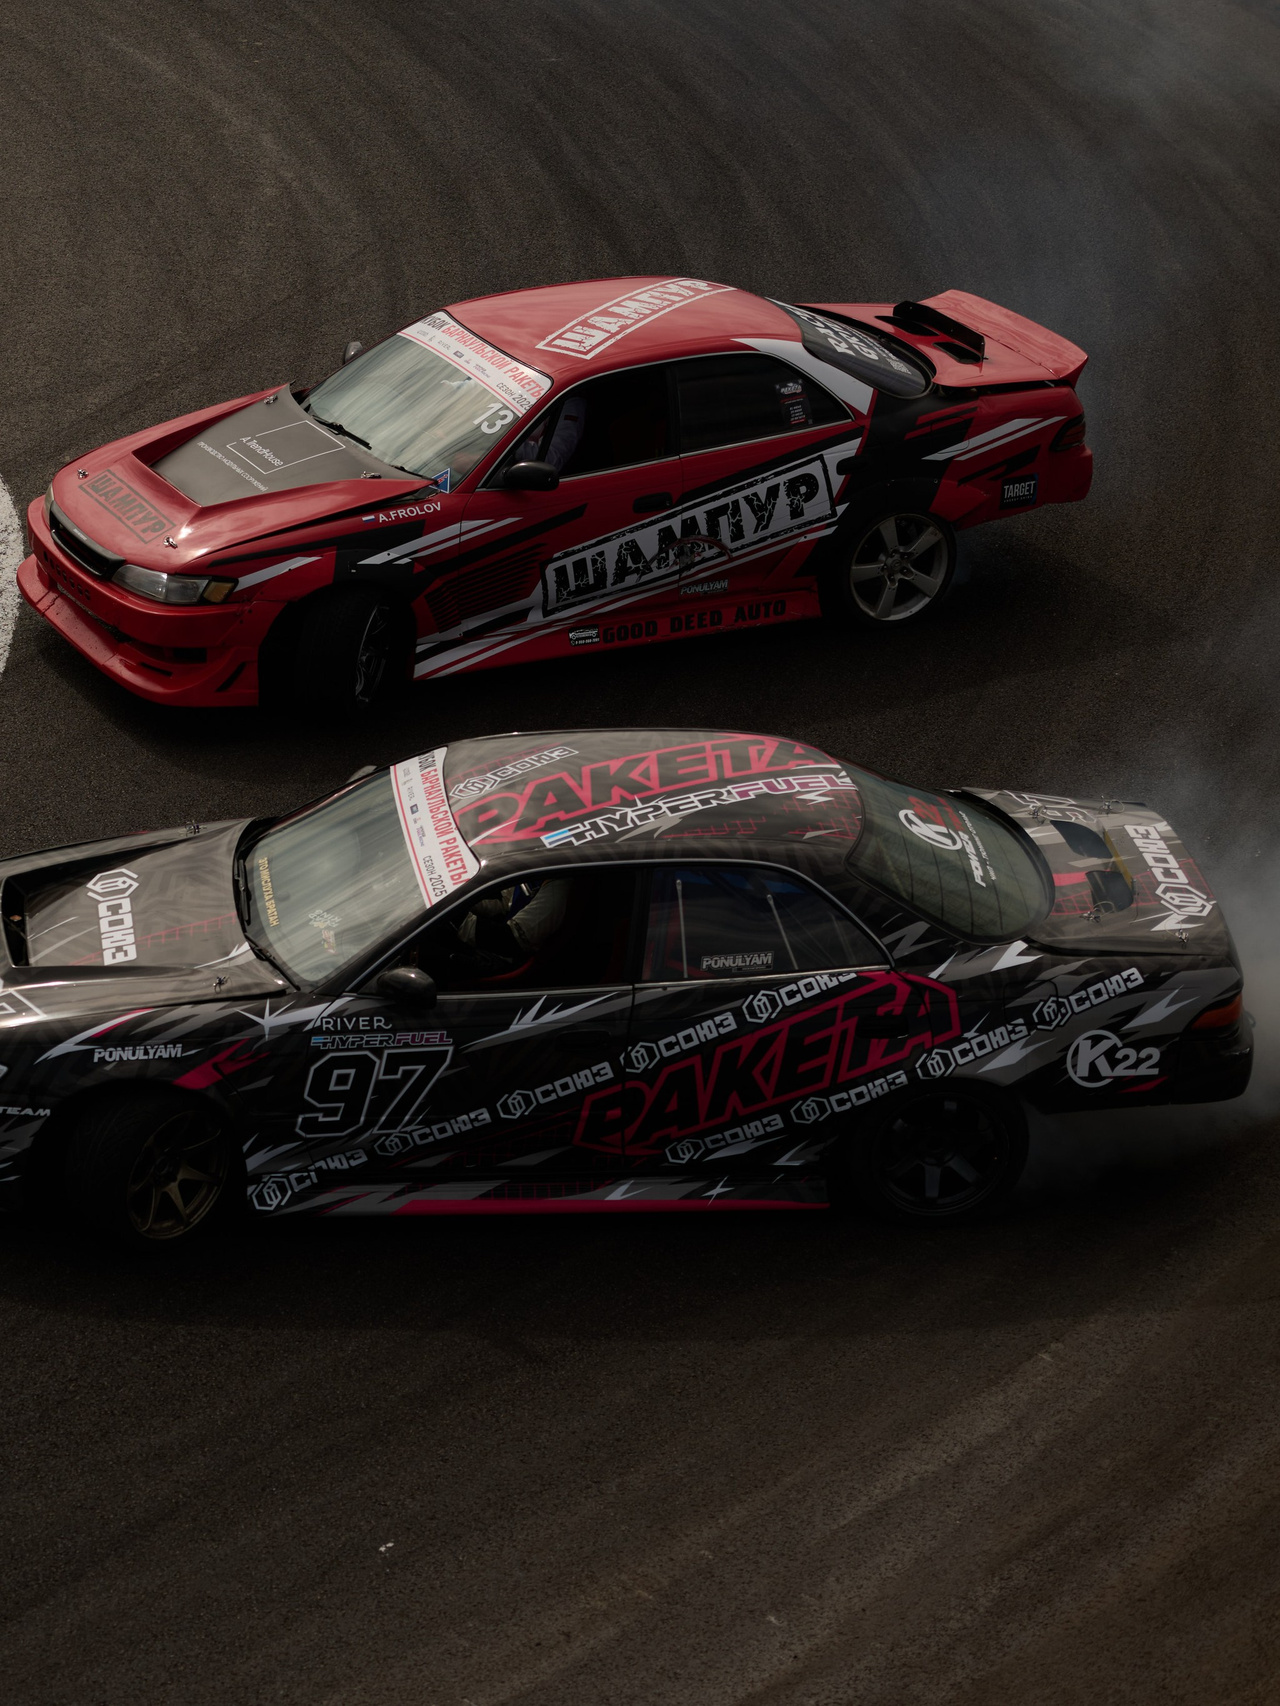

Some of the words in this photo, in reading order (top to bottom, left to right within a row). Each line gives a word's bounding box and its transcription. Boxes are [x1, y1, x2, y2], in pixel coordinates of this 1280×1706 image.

[551, 280, 713, 352] ШАМПУР
[472, 402, 514, 434] 13
[86, 473, 167, 534] ШАМПУР
[1003, 480, 1036, 499] TARGET
[378, 501, 442, 525] A.FROLOV
[554, 472, 820, 604] ШАМПУР
[680, 579, 729, 595] PONULYAM
[602, 620, 658, 643] GOOD
[669, 610, 723, 633] DEED
[734, 599, 787, 623] AUTO
[422, 855, 436, 876] СЕЗОН
[430, 874, 447, 897] 2025
[958, 830, 987, 887] POWER
[97, 897, 137, 966] СОЮЗ
[702, 952, 773, 970] PONULYAM
[1070, 966, 1146, 1015] СОЮЗ
[321, 1016, 393, 1031] RIVER
[657, 1011, 738, 1058] СОЮЗ
[93, 1043, 183, 1064] PONULYAM
[1068, 1032, 1161, 1083] K22
[295, 1045, 455, 1138] 97
[534, 1060, 615, 1105] СОЮЗ
[831, 1070, 909, 1113] СОЮЗ
[411, 1107, 493, 1146] СОЮЗ
[703, 1113, 785, 1150] СОЮЗ
